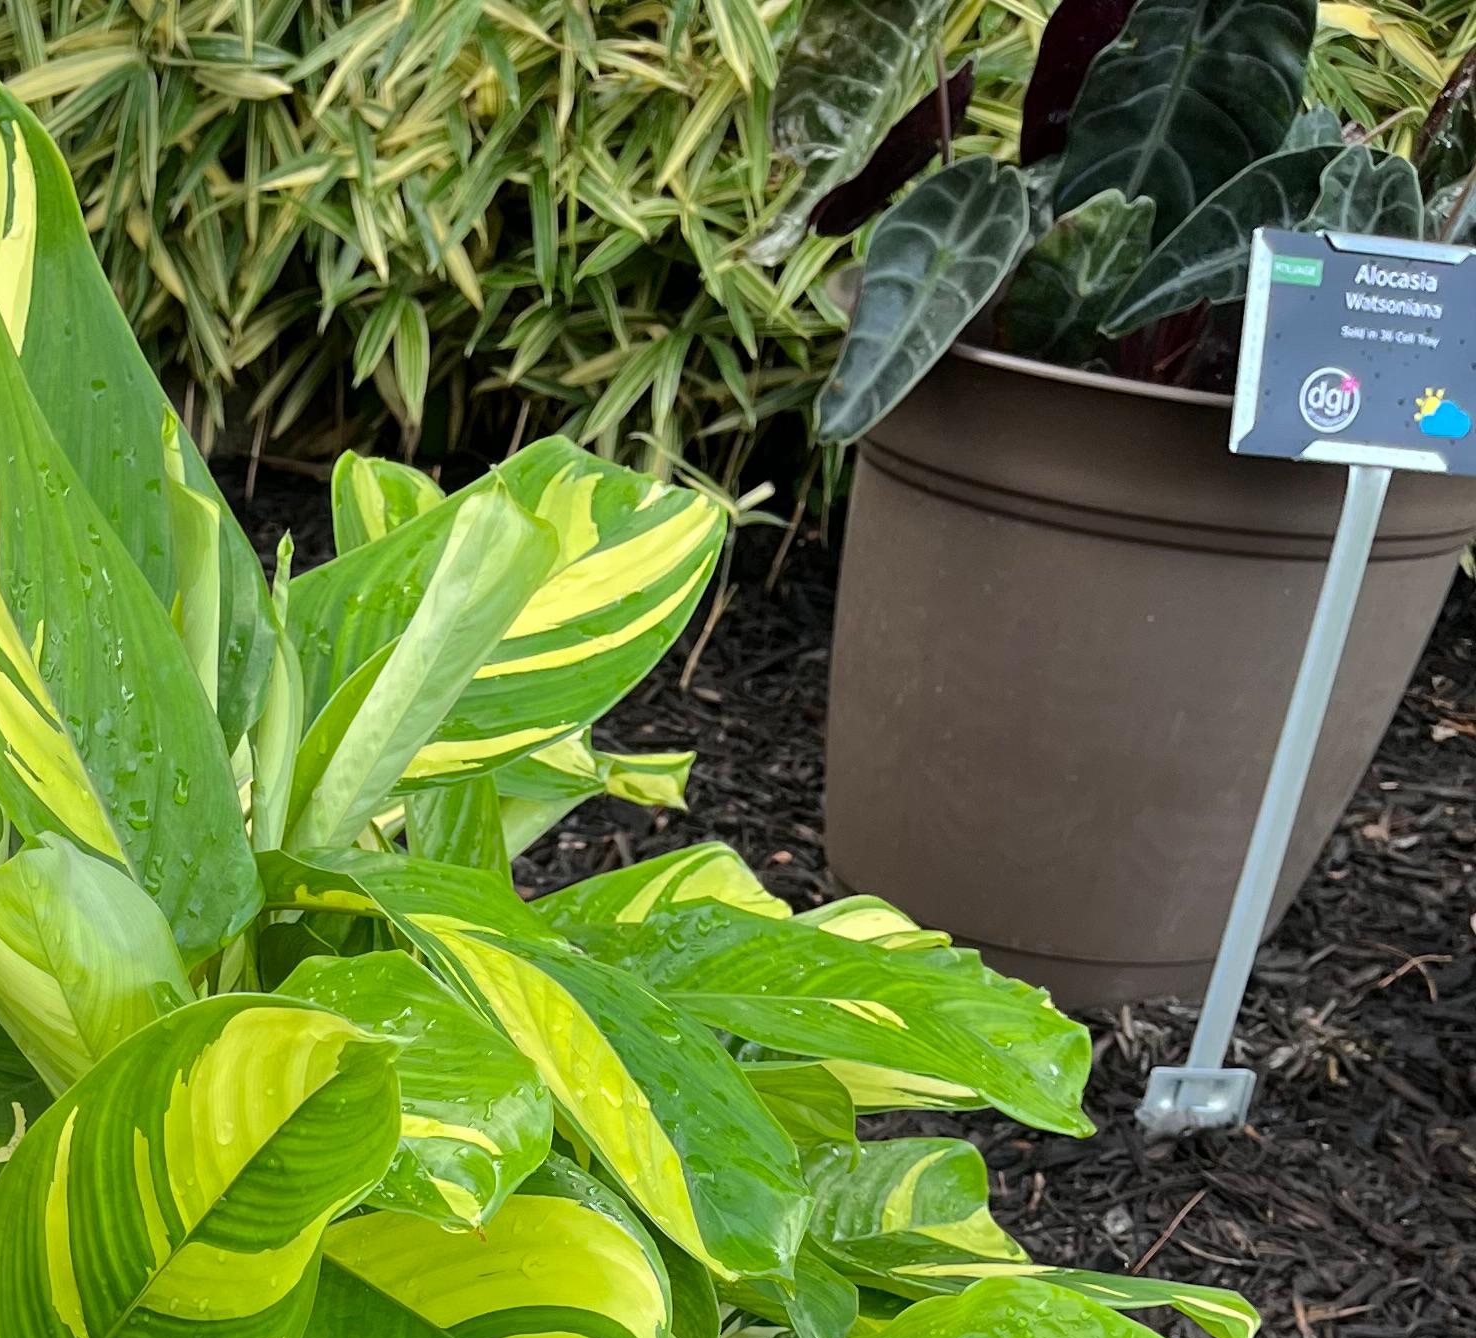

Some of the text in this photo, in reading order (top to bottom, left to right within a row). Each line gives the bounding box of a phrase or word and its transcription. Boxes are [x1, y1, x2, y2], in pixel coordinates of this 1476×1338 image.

[1355, 263, 1438, 292] Alocasia
[1345, 291, 1443, 320] Watsoniana
[1340, 324, 1366, 340] Sold
[1367, 328, 1378, 340] in
[1395, 331, 1416, 345] Cell
[1416, 333, 1441, 348] Tray
[1307, 380, 1352, 416] dgi
